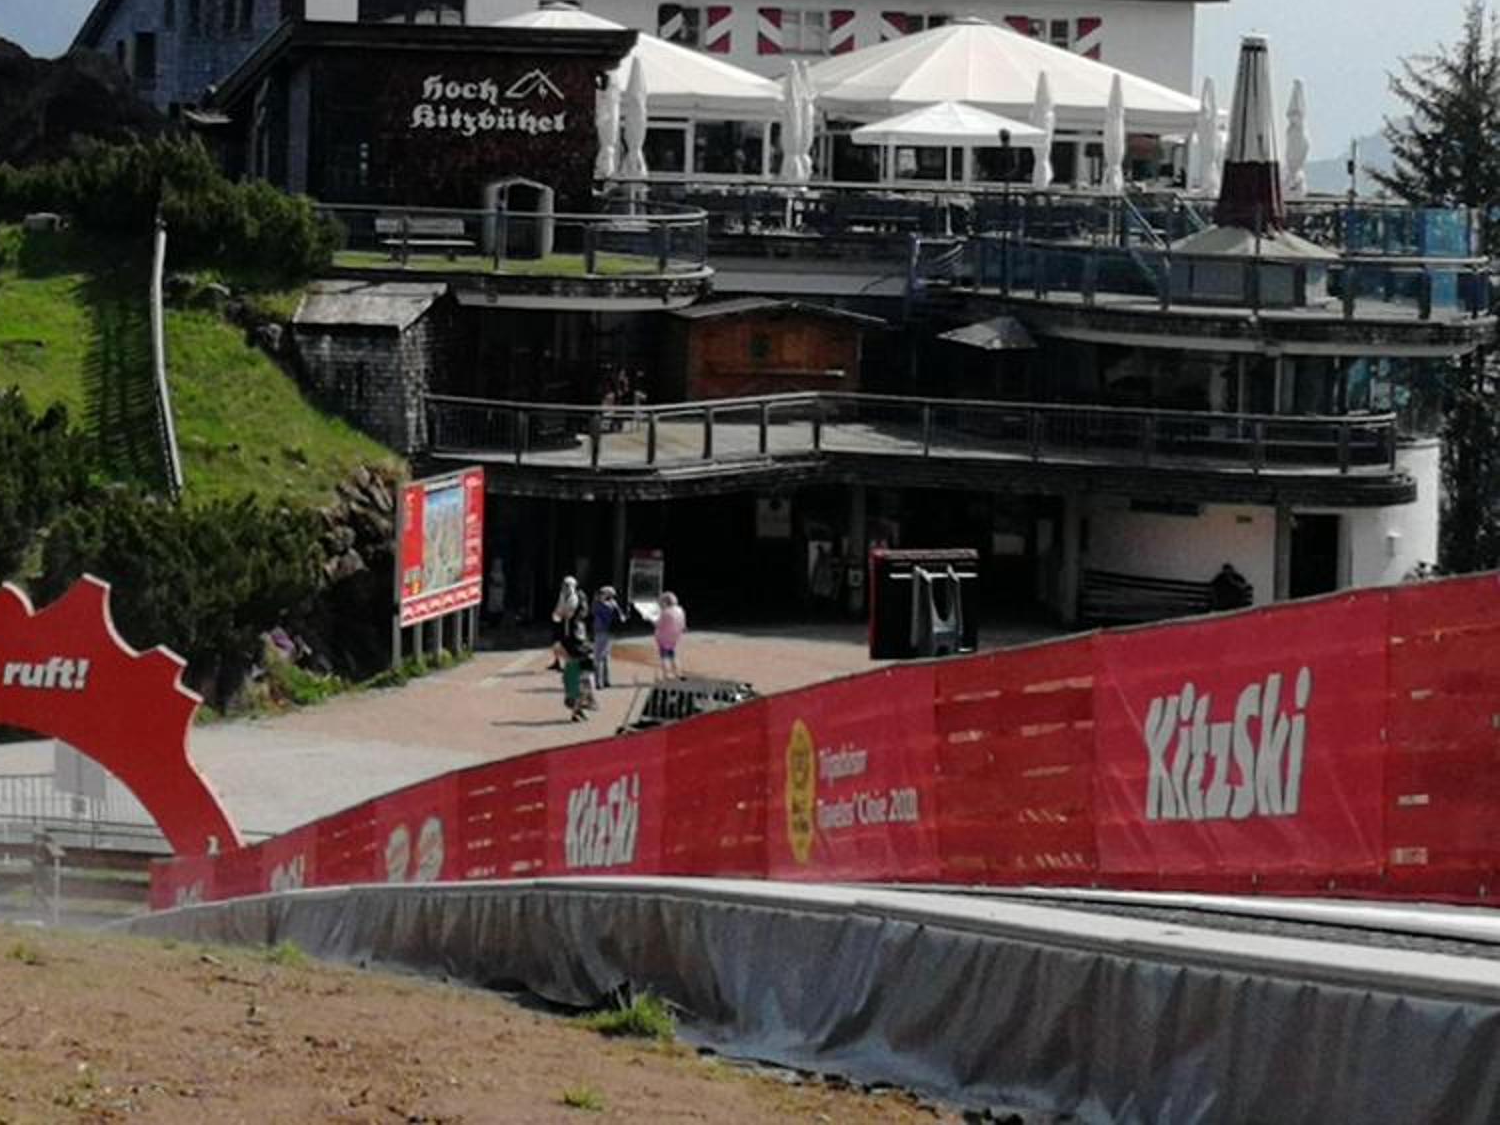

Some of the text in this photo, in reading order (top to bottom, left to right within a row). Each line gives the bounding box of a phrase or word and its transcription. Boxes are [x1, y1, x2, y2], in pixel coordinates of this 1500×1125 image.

[422, 74, 499, 105] Hoch
[410, 104, 565, 136] Kitzbühel
[3, 657, 90, 690] ruft!
[1143, 666, 1312, 821] KitzSki
[565, 773, 641, 869] KitzSki
